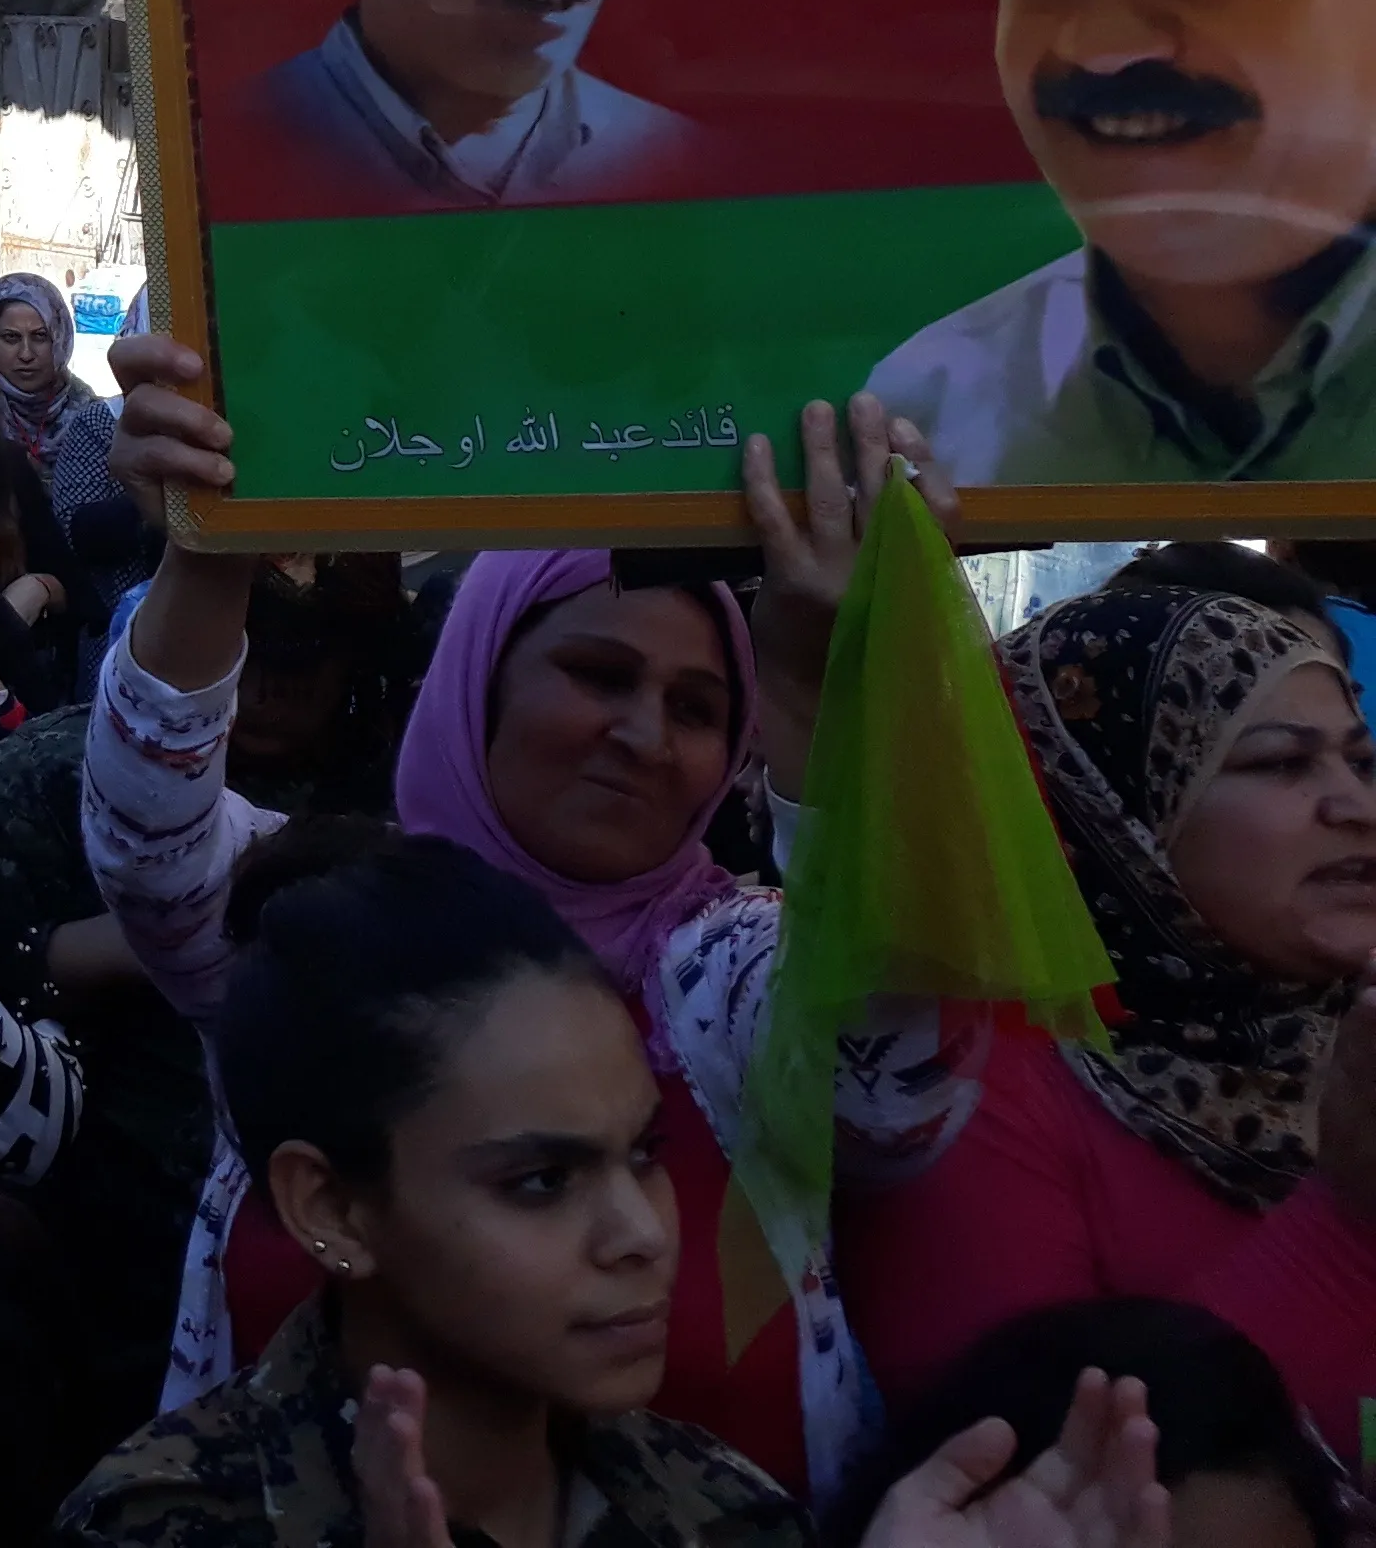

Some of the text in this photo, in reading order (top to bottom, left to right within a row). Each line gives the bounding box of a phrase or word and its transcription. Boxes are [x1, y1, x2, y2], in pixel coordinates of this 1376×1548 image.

[504, 405, 559, 454] الله
[580, 419, 655, 463] عبد
[660, 403, 740, 450] قائد
